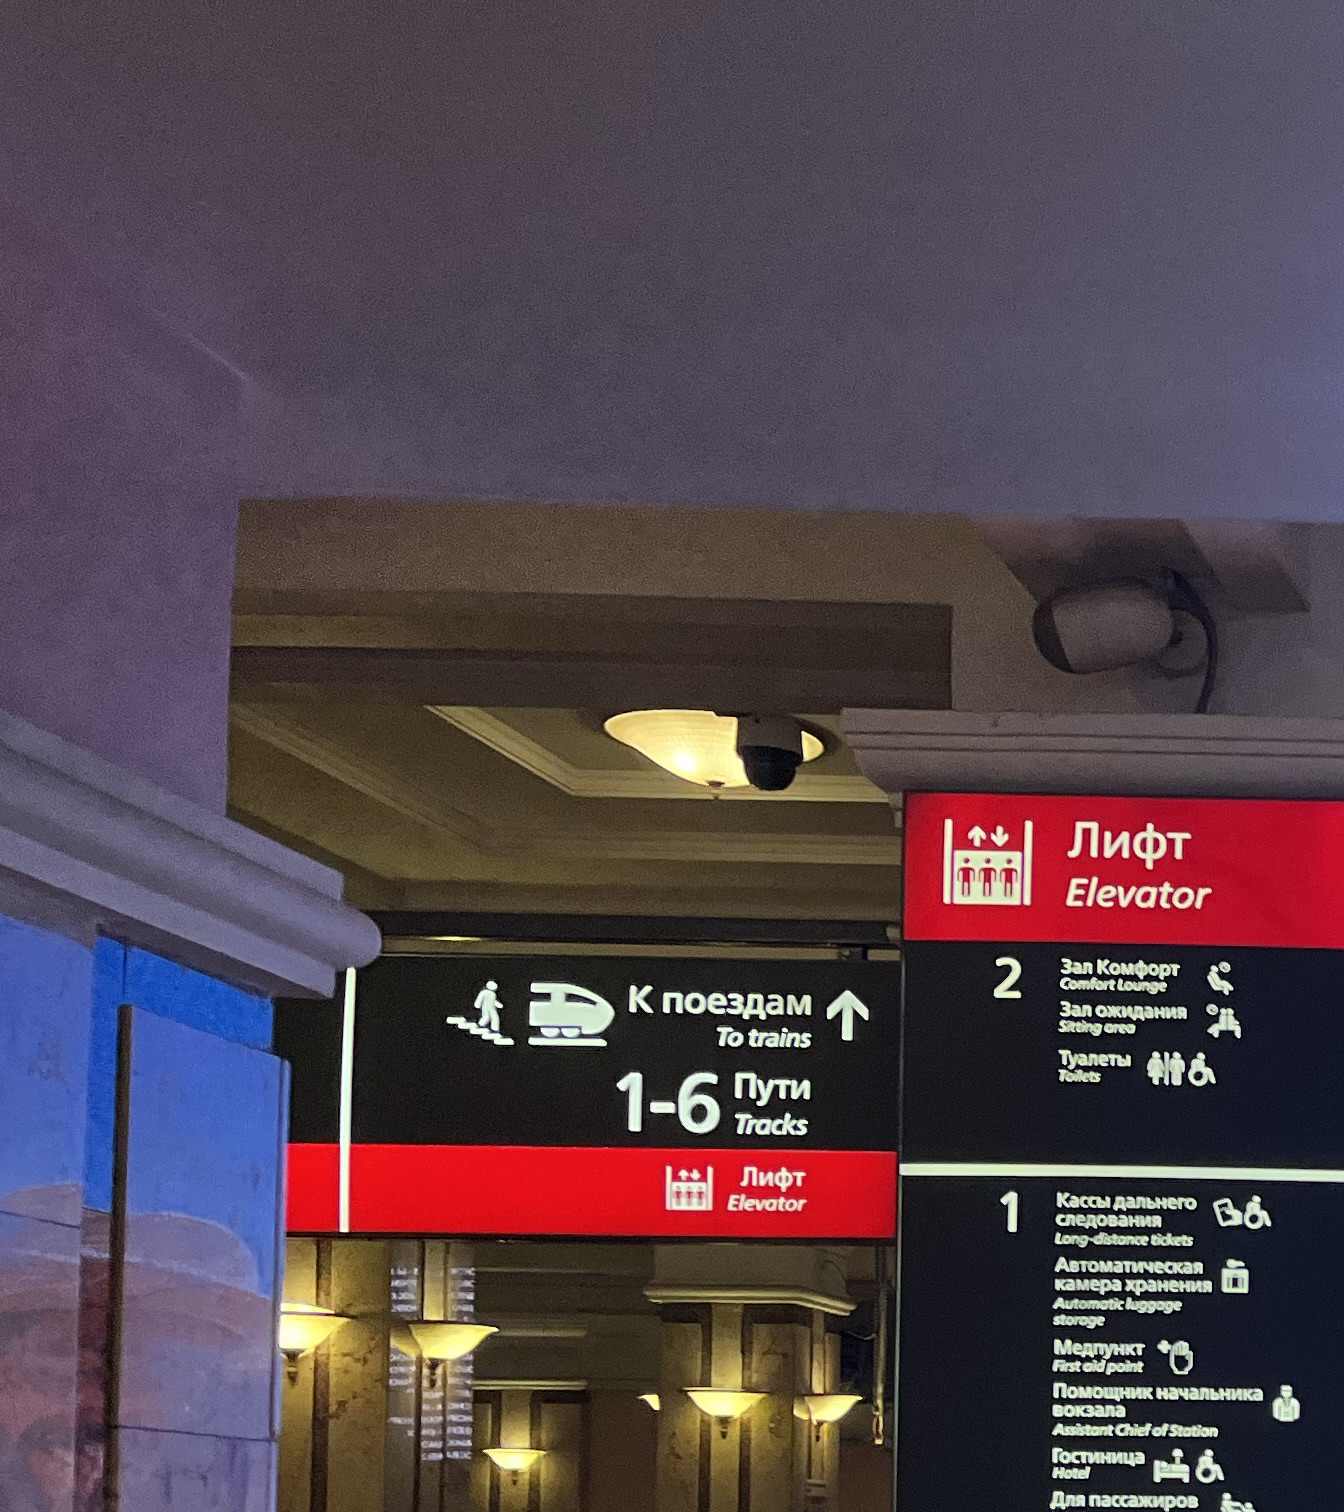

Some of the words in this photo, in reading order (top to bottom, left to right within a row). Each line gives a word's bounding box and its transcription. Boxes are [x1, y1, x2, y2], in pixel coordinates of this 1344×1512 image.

[1067, 821, 1192, 870] Лифт
[1065, 877, 1212, 911] Elevator
[993, 957, 1022, 999] 2
[1060, 958, 1092, 976] Зал
[1096, 960, 1181, 981] Комфорт
[1059, 977, 1115, 992] Comfort
[1117, 979, 1167, 994] Lounge
[628, 985, 653, 1014] К
[661, 990, 812, 1021] поездам
[1059, 1001, 1092, 1018] Зал
[1095, 1003, 1187, 1022] ожидания
[716, 1026, 743, 1048] To
[747, 1027, 812, 1049] trains
[1058, 1020, 1101, 1036] Sitting
[1103, 1022, 1136, 1036] area
[1058, 1049, 1131, 1072] Туалеты
[1058, 1069, 1101, 1084] Toilets
[734, 1073, 811, 1107] Пути
[615, 1072, 721, 1135] 1-6
[734, 1113, 808, 1137] Tracks
[740, 1165, 806, 1195] Лифт
[727, 1193, 807, 1214] Elevator
[1056, 1192, 1110, 1209] Кассы
[1113, 1194, 1197, 1211] дальнего
[1000, 1191, 1019, 1233] 1
[1055, 1213, 1162, 1229] следования
[1054, 1232, 1148, 1247] Long-distance
[1150, 1233, 1194, 1247] tickets
[1054, 1257, 1204, 1275] Автоматическая
[1054, 1278, 1122, 1295] камера
[1125, 1278, 1212, 1295] хранения
[1053, 1297, 1123, 1311] Automatic
[1124, 1298, 1183, 1313] luggage
[1052, 1314, 1105, 1328] storage
[1052, 1339, 1146, 1358] Медпункт
[1052, 1360, 1080, 1372] First
[1082, 1360, 1105, 1373] aid
[1106, 1361, 1144, 1375] point
[1052, 1383, 1153, 1402] Помощник
[1156, 1385, 1264, 1402] начальника
[1052, 1404, 1126, 1418] вокзала
[1051, 1423, 1113, 1437] Assistant
[1115, 1423, 1150, 1437] Chief
[1151, 1424, 1168, 1437] of
[1168, 1424, 1219, 1438] Station
[1052, 1447, 1146, 1467] Гостиница
[1051, 1467, 1091, 1480] Hotel
[1049, 1491, 1086, 1510] Для
[1088, 1494, 1199, 1512] пассажиров
